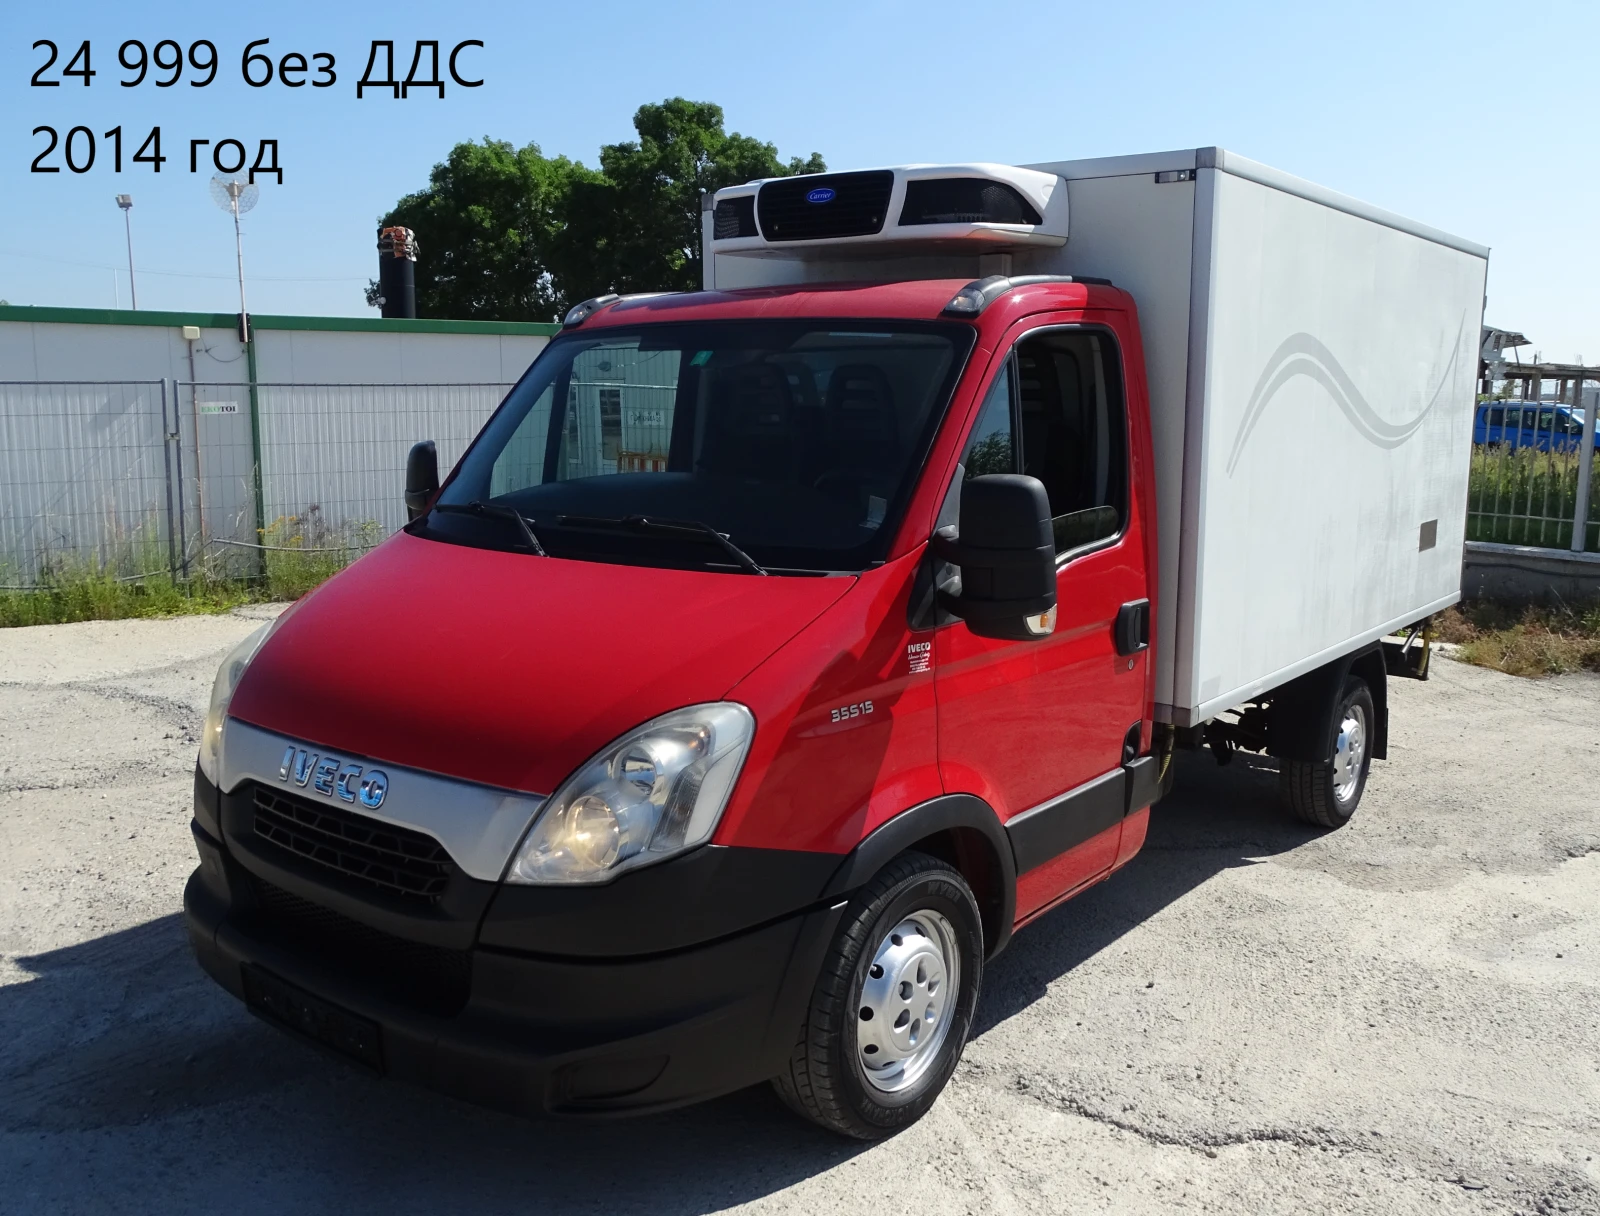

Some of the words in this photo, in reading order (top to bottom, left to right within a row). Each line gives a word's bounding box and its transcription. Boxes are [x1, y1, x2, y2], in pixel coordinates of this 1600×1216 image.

[809, 192, 832, 200] Carrier
[907, 642, 931, 654] IVECO
[831, 700, 874, 723] 35S15
[279, 745, 389, 810] IVECO
